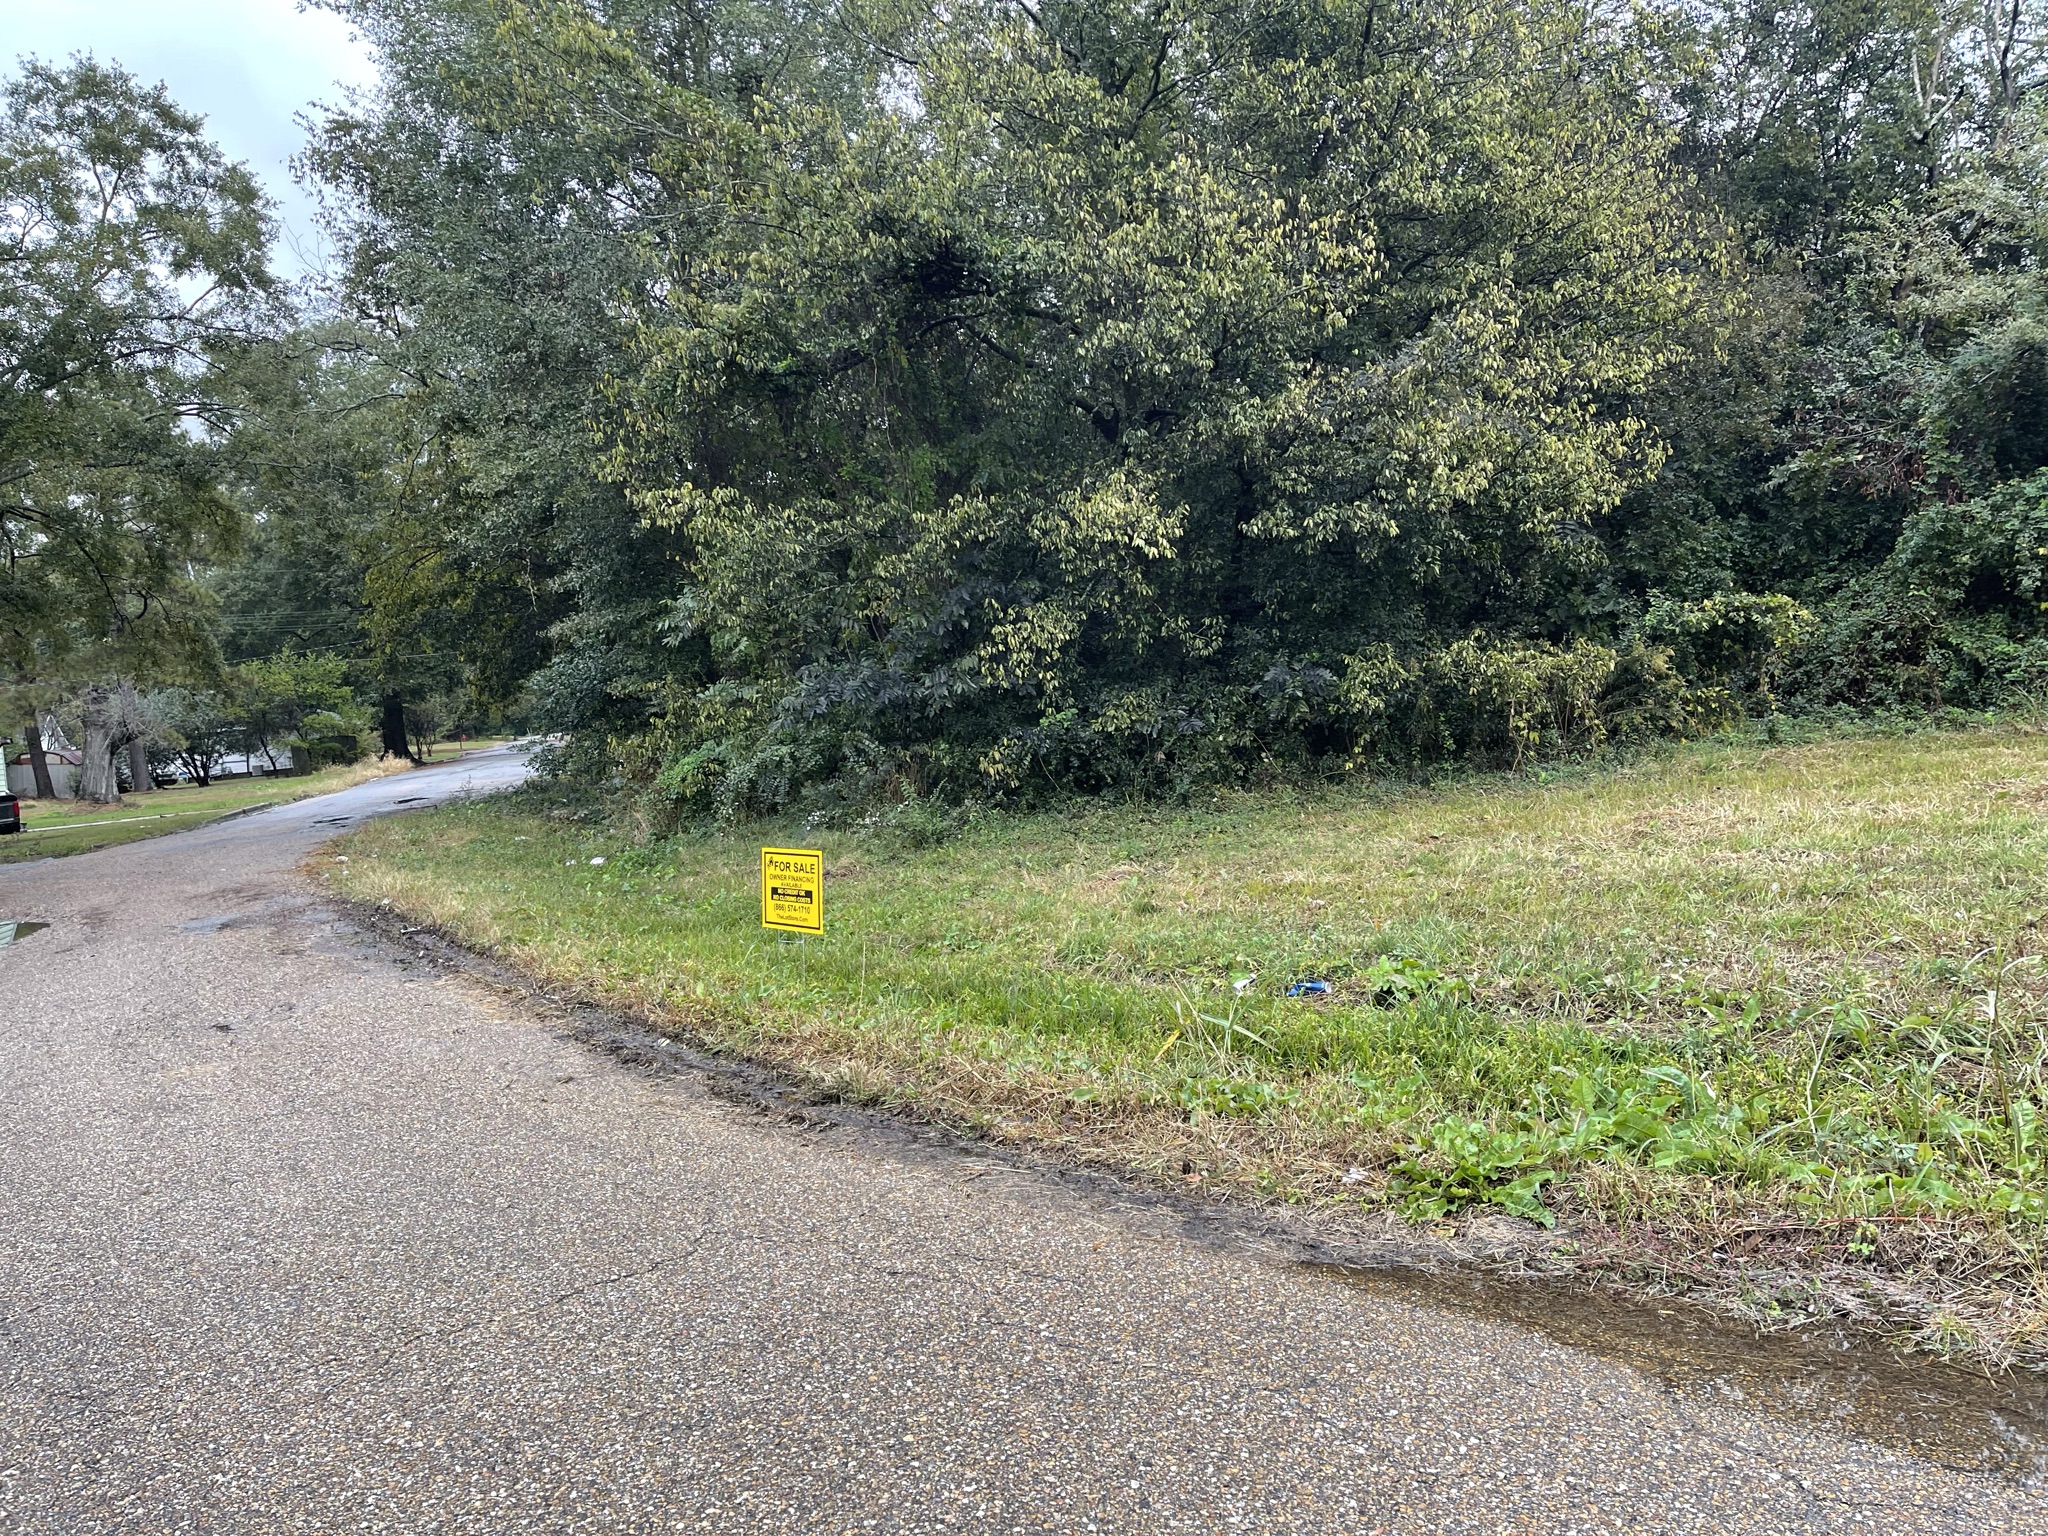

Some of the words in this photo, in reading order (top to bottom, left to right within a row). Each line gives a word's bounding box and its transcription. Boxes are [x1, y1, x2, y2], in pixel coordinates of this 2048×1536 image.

[774, 861, 791, 872] FOR
[793, 862, 815, 874] SALE
[770, 873, 787, 881] OWNER
[788, 875, 814, 883] FINANCING
